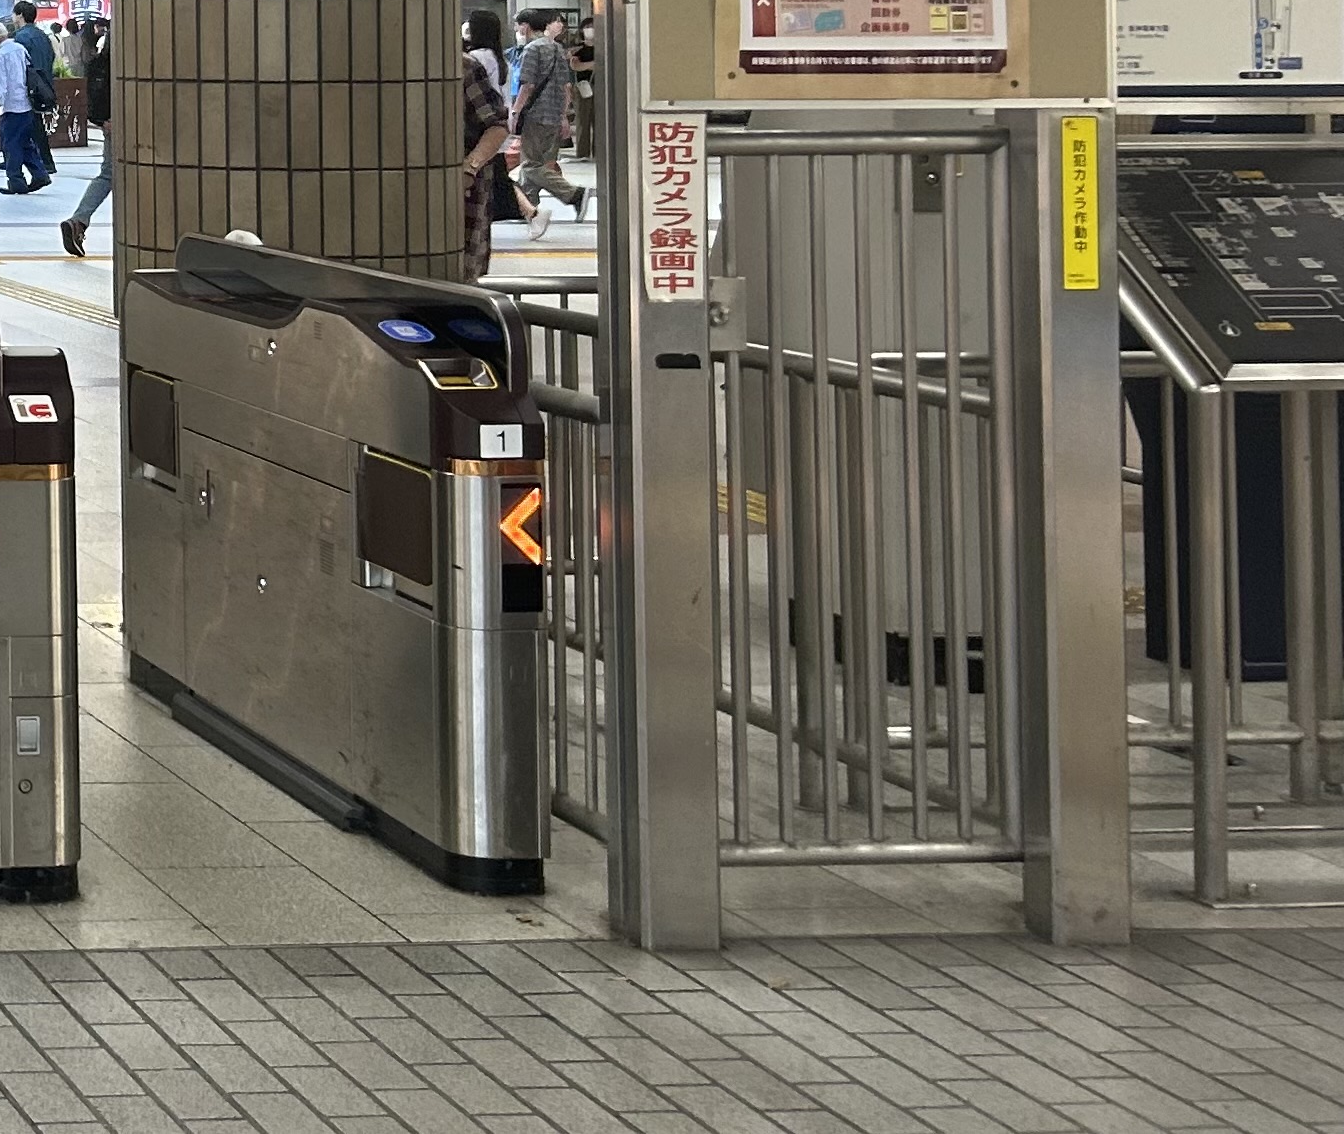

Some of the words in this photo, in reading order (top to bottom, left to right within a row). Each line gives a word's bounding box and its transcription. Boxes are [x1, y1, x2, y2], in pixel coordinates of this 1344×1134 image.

[648, 122, 699, 294] 防犯カメラ録画中
[1073, 140, 1088, 253] 防犯カメラ作動中
[497, 430, 506, 452] 1
